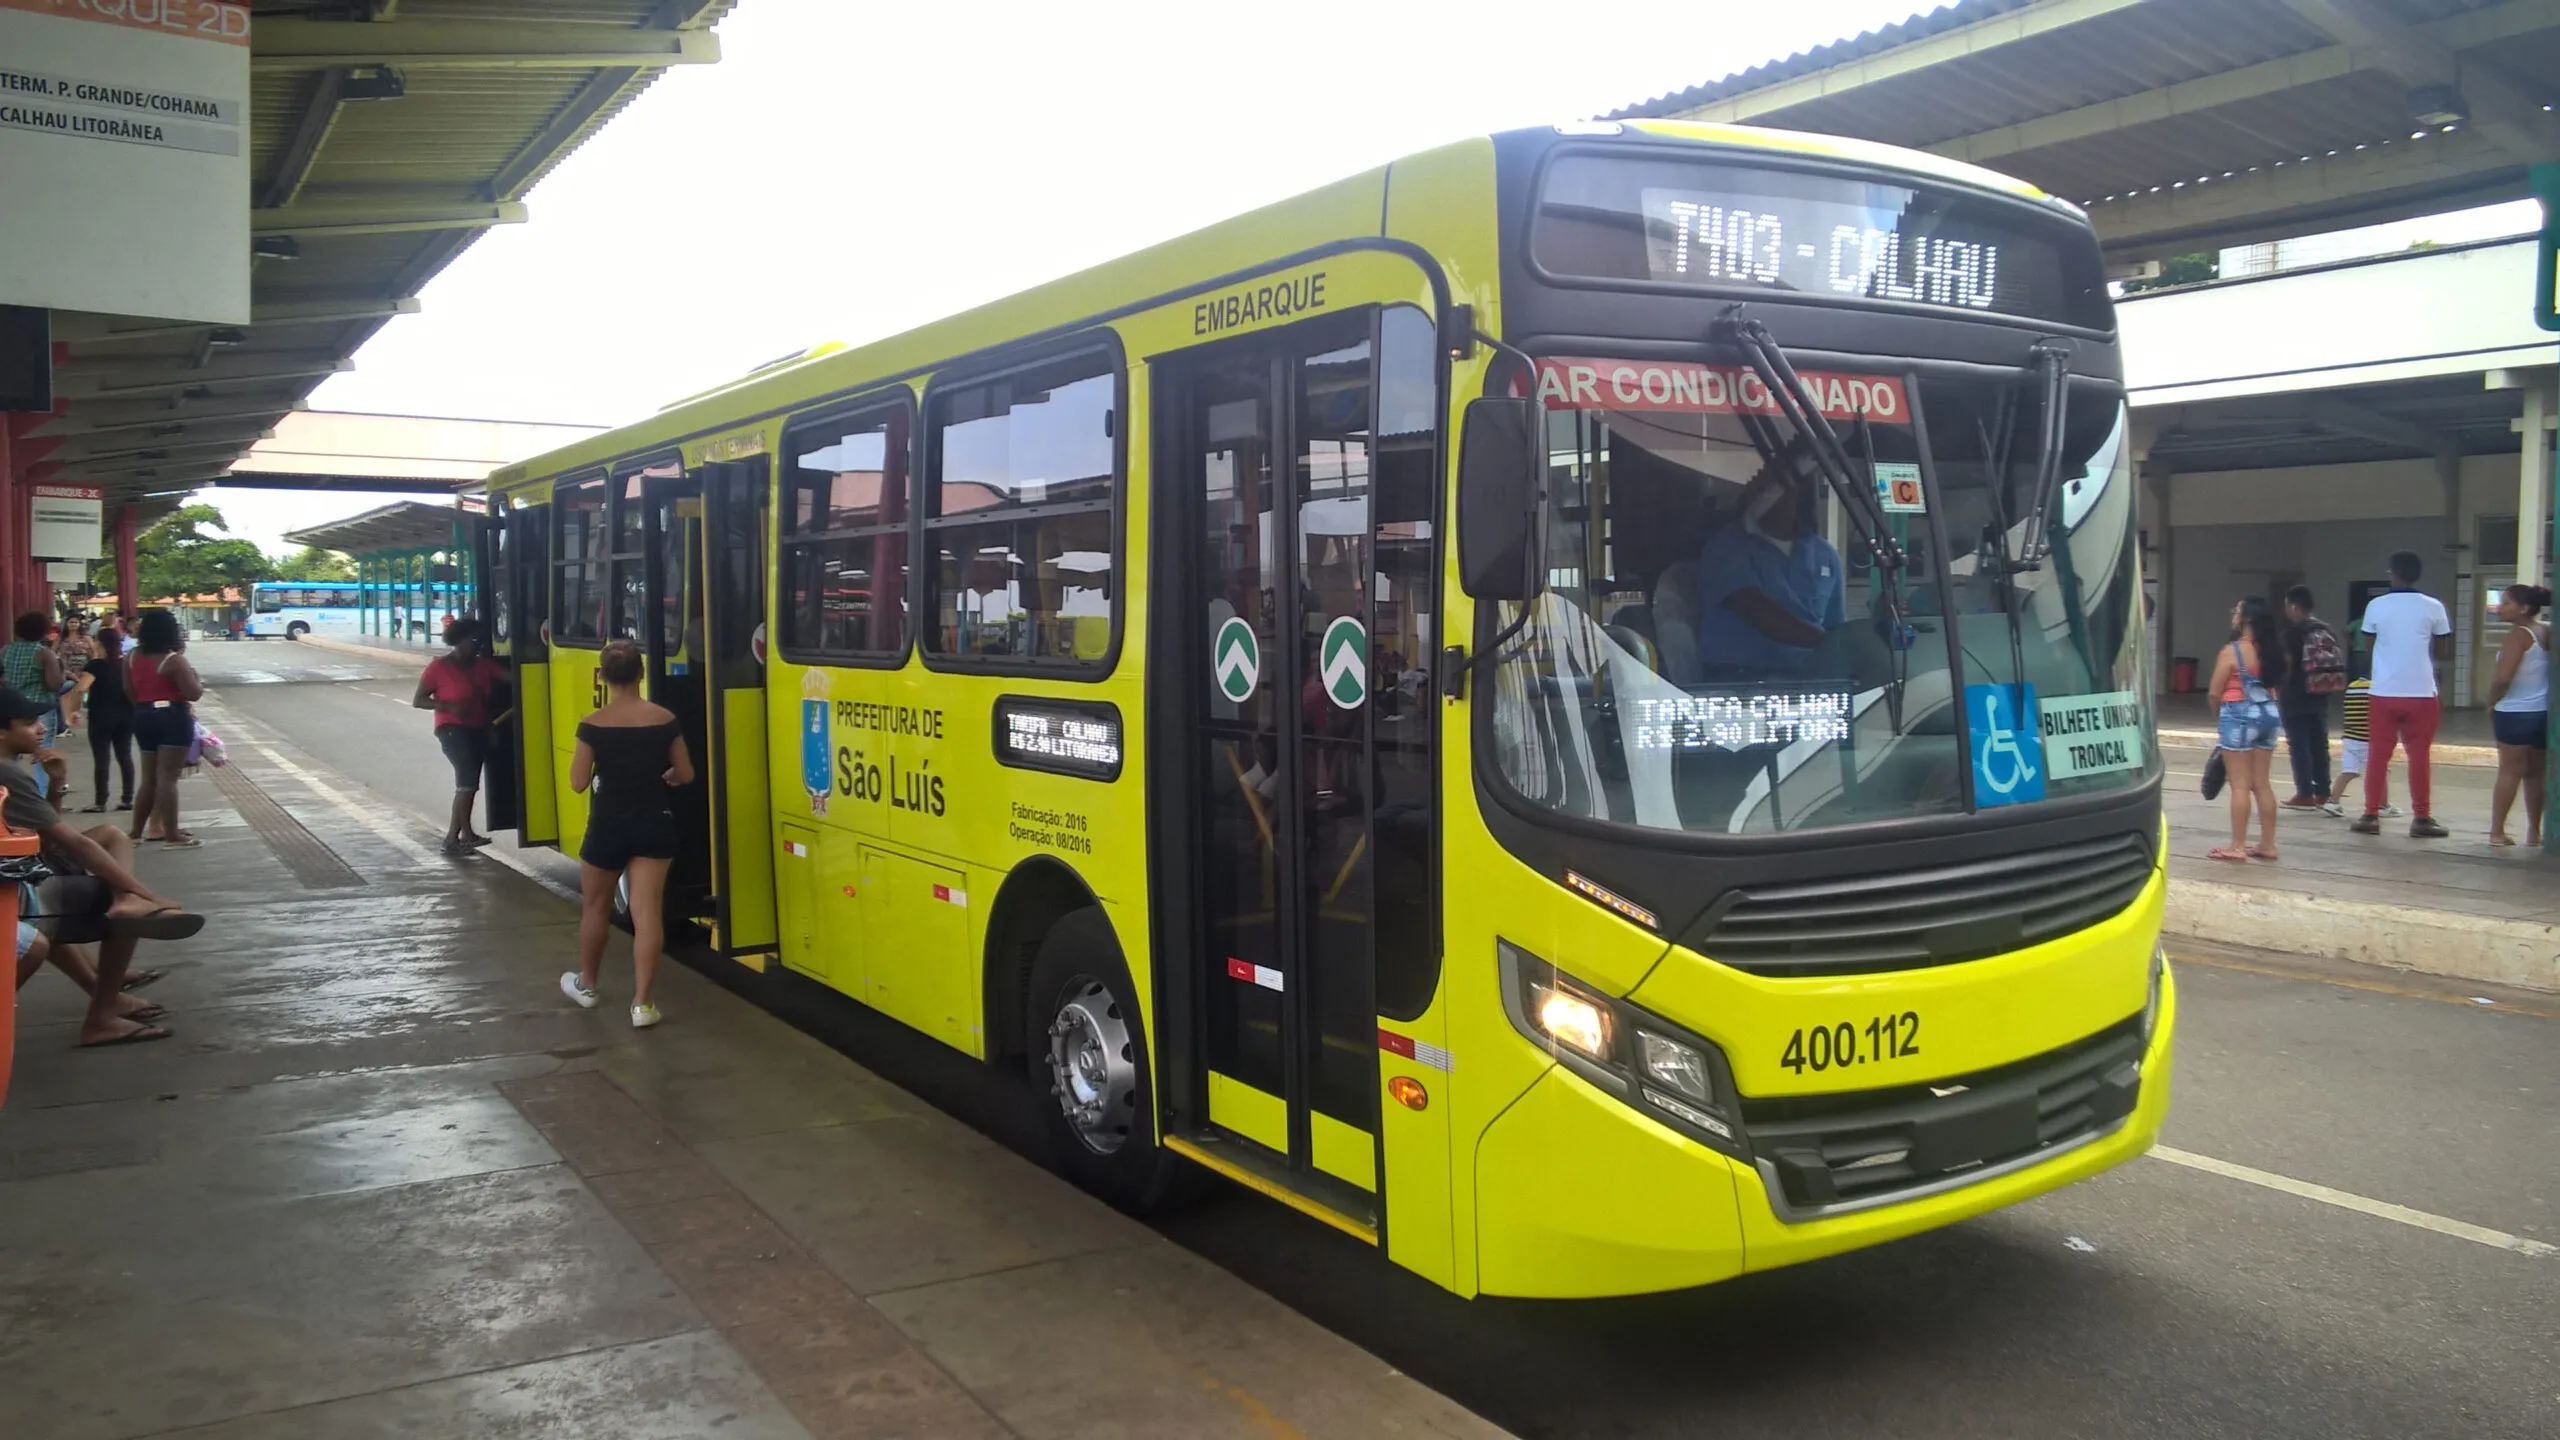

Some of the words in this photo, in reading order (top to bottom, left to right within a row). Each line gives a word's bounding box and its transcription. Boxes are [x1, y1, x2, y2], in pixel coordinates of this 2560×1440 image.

[197, 4, 250, 37] 2D
[0, 72, 53, 95] TERM.
[58, 81, 71, 97] P.
[76, 84, 219, 118] GRANDE/COHAMA
[0, 106, 67, 129] CALHAU
[73, 115, 164, 142] LITORÂNEA
[1670, 200, 1781, 284] T403
[1829, 223, 1997, 308] CALHAU
[1194, 272, 1327, 336] EMBARQUE
[1537, 365, 1601, 403] AR
[836, 700, 920, 737] PREFEITURA
[922, 708, 944, 740] DE
[1637, 696, 1743, 722] TARIFA
[1749, 692, 1849, 719] CALHAU
[2043, 707, 2101, 737] BILHETE
[2102, 700, 2139, 730] ÚNICO
[1062, 720, 1108, 743] CALHAU
[1749, 717, 1849, 744] LITORA
[2069, 740, 2129, 770] TRONCAL
[838, 745, 882, 804] São
[889, 754, 946, 818] Luís
[1011, 802, 1063, 829] Fabricação:
[1065, 812, 1087, 832] 2016
[1009, 821, 1055, 847] Operação:
[1056, 831, 1092, 855] 08/2016
[1780, 1010, 1920, 1076] 400.112
